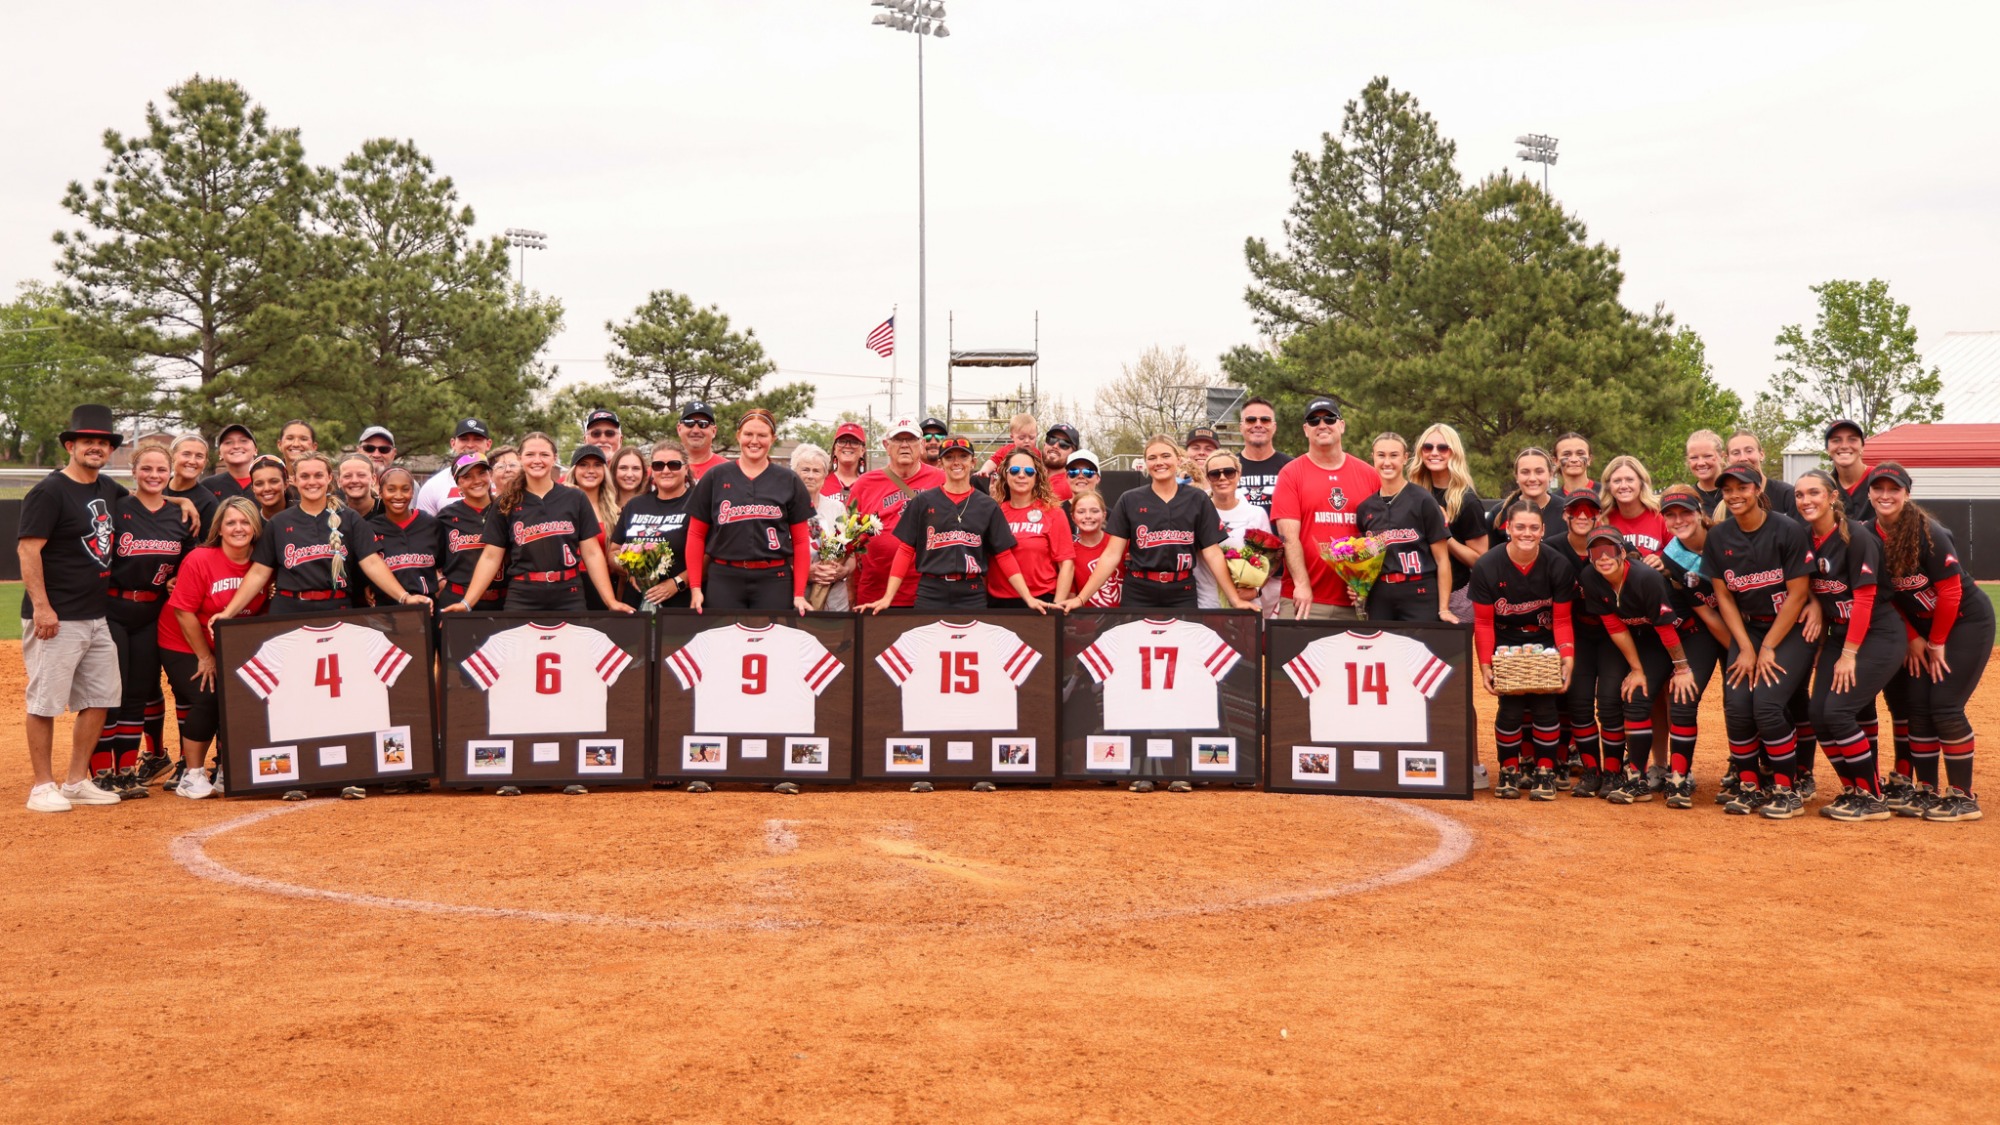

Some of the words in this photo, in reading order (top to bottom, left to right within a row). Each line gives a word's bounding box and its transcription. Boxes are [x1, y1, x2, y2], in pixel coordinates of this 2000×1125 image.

[1238, 475, 1261, 486] STIN
[631, 513, 663, 524] AUSTIN
[663, 513, 686, 524] PEAY
[718, 500, 783, 525] Governors
[1315, 511, 1343, 524] AUSTIN
[513, 520, 576, 546] Governors
[766, 526, 780, 550] 9
[1020, 522, 1044, 534] PEAY
[1637, 534, 1659, 551] PEAY
[378, 551, 436, 572] overnors
[562, 543, 577, 567] 6
[1176, 553, 1193, 571] 17
[1398, 550, 1422, 574] 14
[420, 576, 429, 595] 1
[1724, 568, 1784, 593] Governor
[314, 653, 343, 698] 4
[535, 651, 562, 695] 6
[741, 652, 768, 695] 9
[939, 650, 980, 695] 15
[1139, 646, 1179, 690] 17
[1344, 661, 1389, 706] 14
